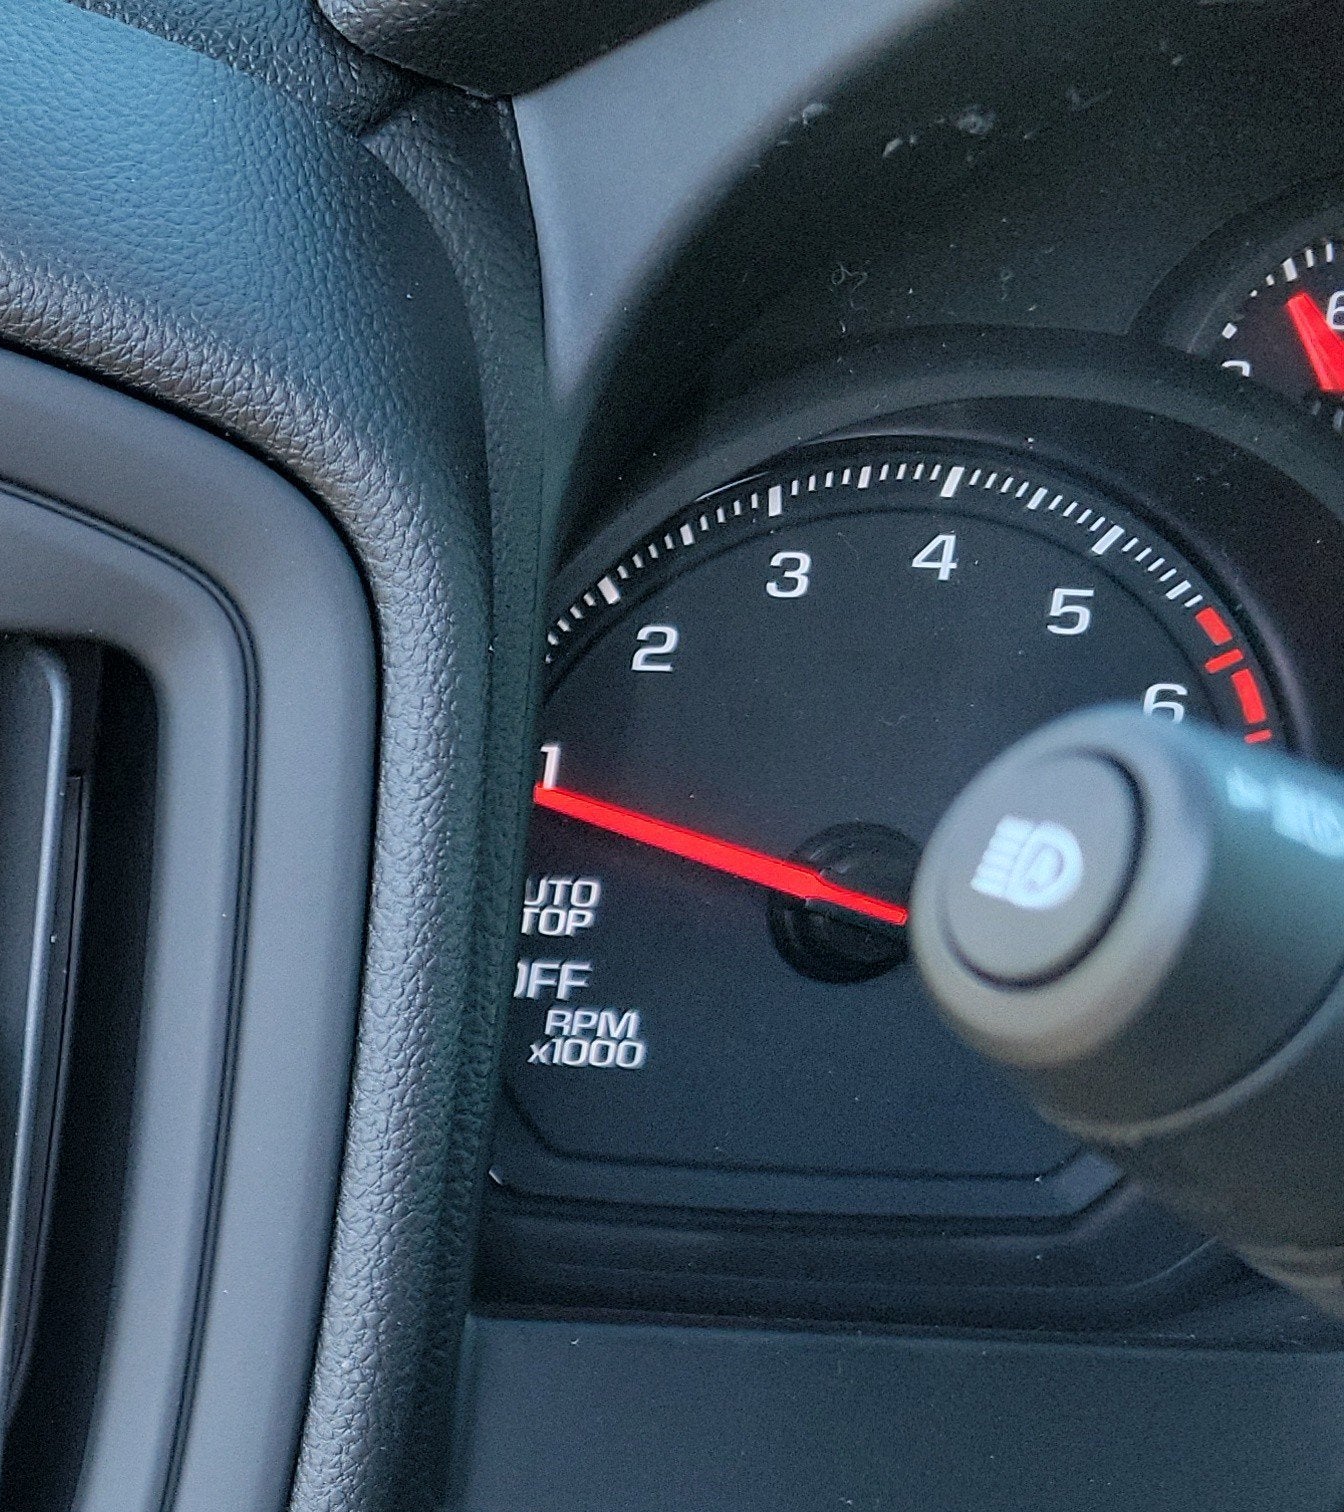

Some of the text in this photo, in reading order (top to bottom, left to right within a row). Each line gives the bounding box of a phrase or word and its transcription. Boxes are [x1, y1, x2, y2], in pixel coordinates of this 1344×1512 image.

[766, 551, 811, 598] 3
[912, 534, 958, 581] 4
[1047, 588, 1094, 635] 5
[630, 625, 678, 672] 2
[1143, 683, 1188, 724] 6
[540, 744, 561, 789] 1
[524, 877, 600, 908] UTO
[521, 907, 593, 936] TOP
[544, 1008, 640, 1038] RPM
